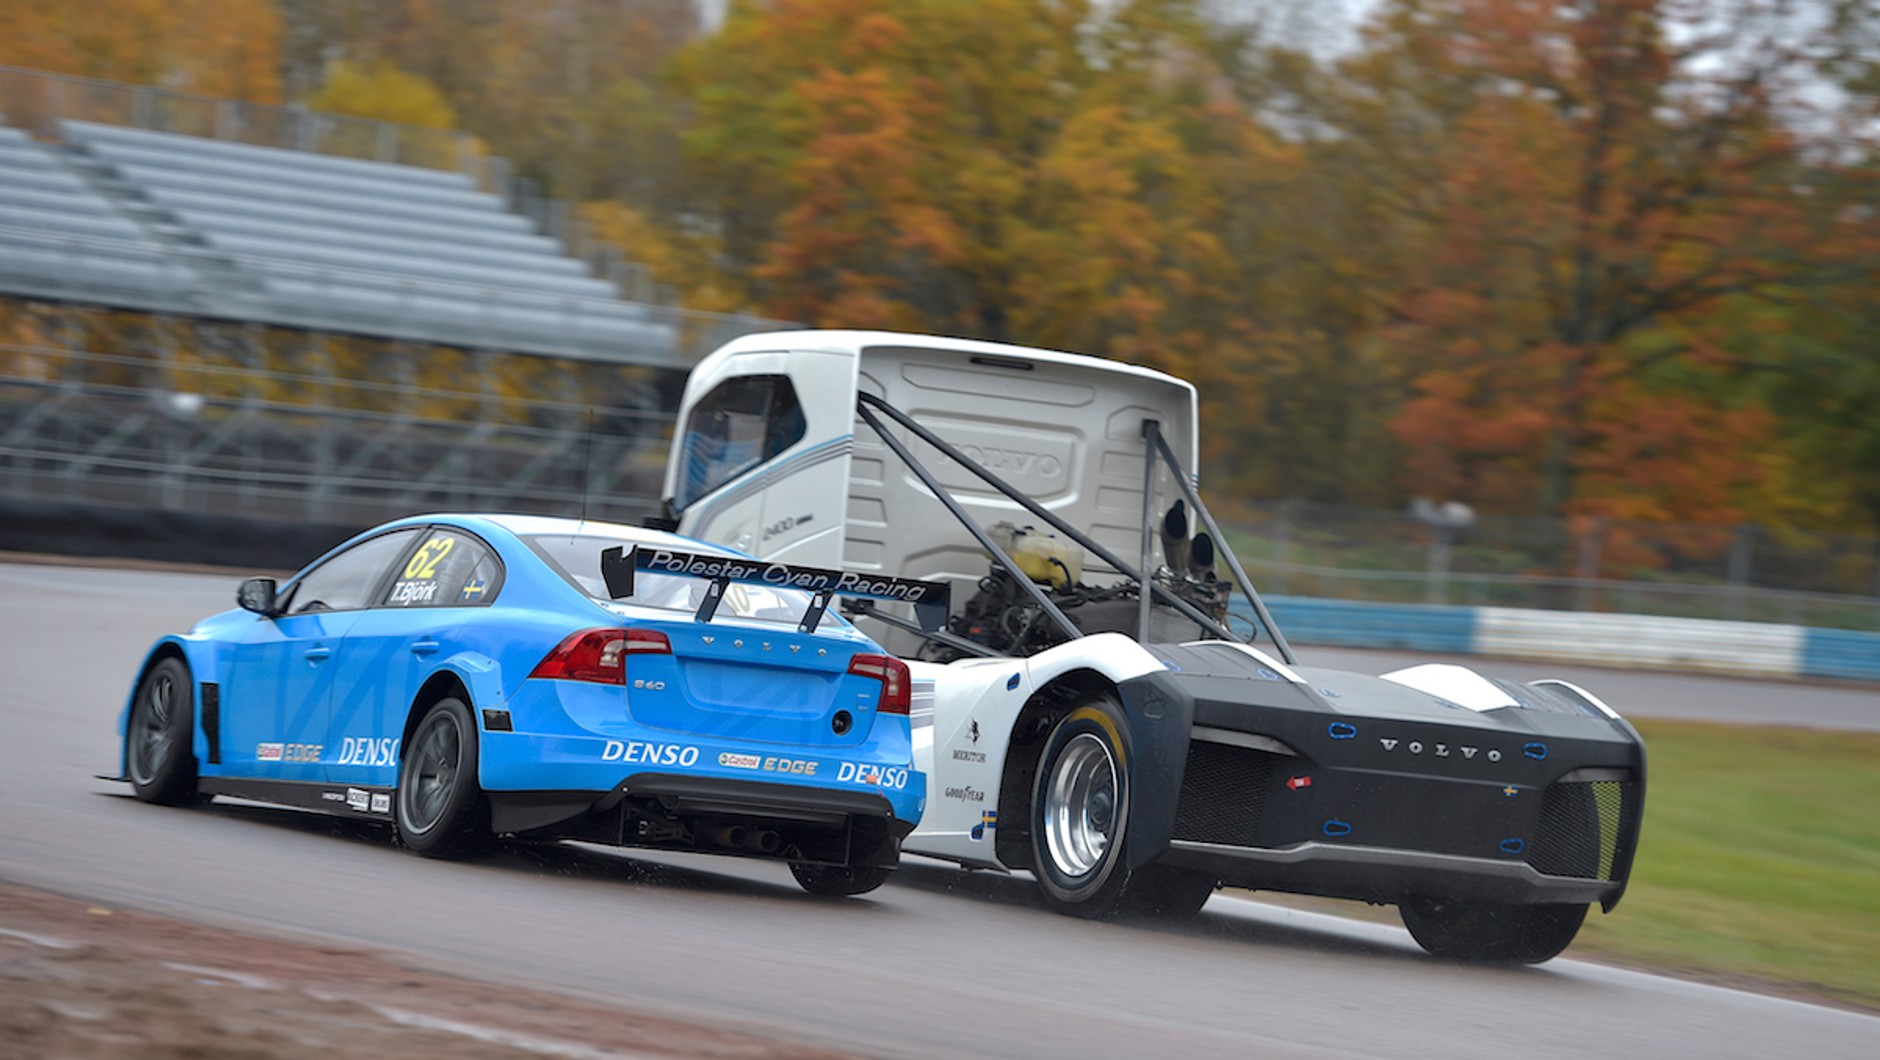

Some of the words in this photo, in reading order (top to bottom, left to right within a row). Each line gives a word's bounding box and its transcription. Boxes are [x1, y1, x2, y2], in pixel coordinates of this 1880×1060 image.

[934, 442, 1062, 480] OLVO
[404, 537, 455, 579] 62
[647, 549, 757, 579] Polestar
[762, 563, 829, 588] Cyan
[835, 571, 927, 600] Racing
[702, 636, 828, 656] VOLVO
[601, 740, 699, 767] DENSO
[1380, 737, 1502, 763] VOLVO
[763, 756, 819, 775] EDGE
[837, 761, 908, 789] DENSO
